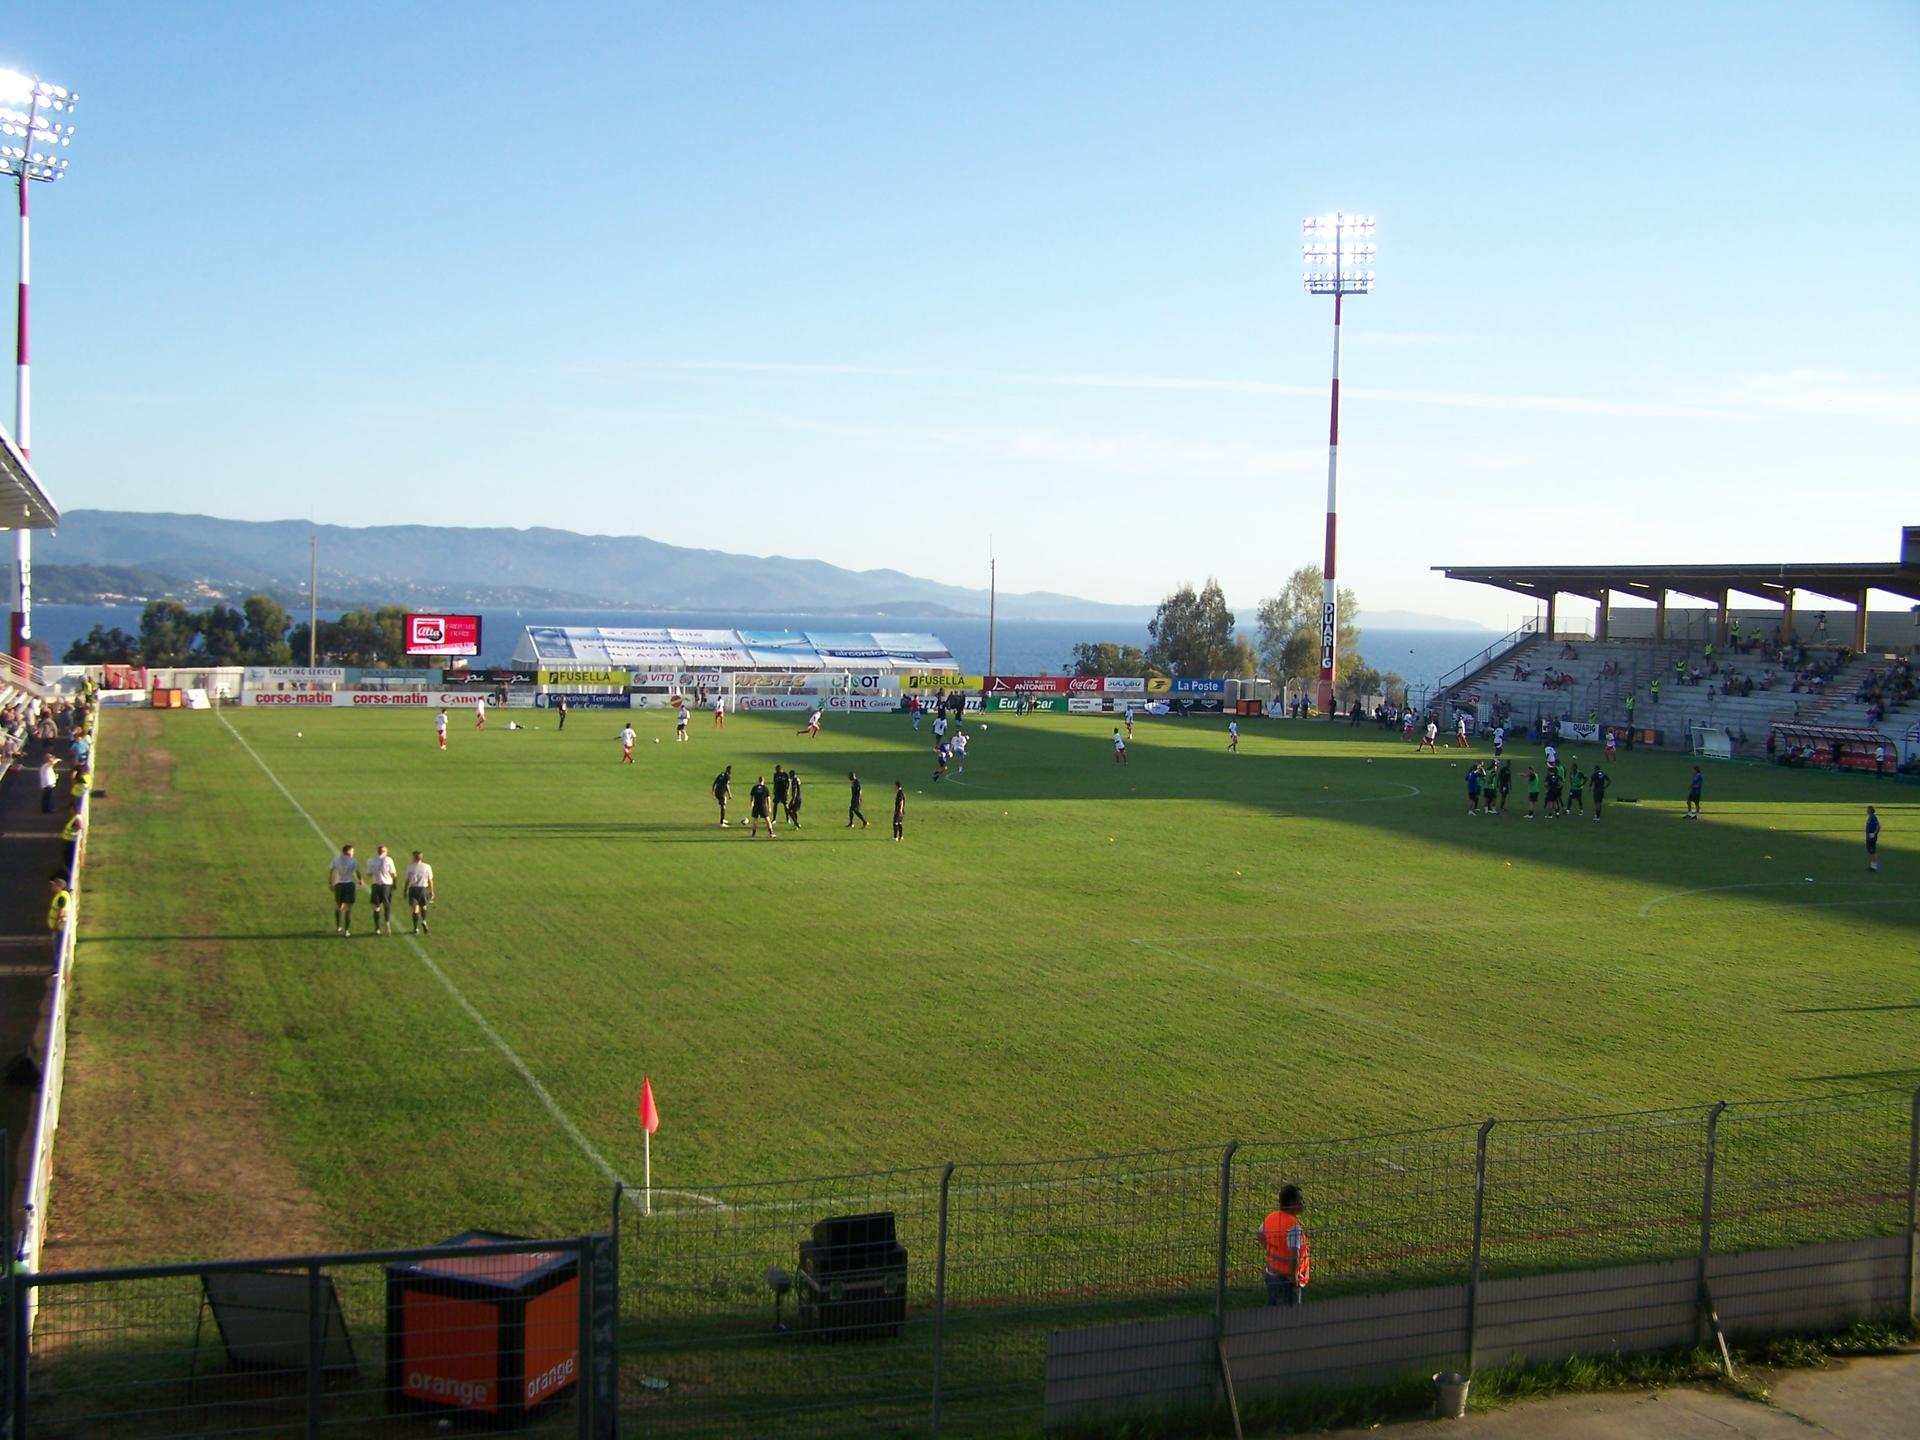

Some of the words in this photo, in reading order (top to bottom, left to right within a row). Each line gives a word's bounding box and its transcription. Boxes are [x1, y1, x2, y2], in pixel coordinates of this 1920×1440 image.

[1322, 603, 1334, 669] DUARIG
[308, 668, 342, 676] SERVICES
[560, 672, 610, 681] FUSELLA
[919, 676, 965, 685] FUSELLA
[1177, 680, 1189, 690] La
[1191, 680, 1218, 691] Poste
[1014, 683, 1056, 691] ANTONETTI
[256, 692, 333, 703] corse-matin
[353, 692, 428, 704] corse-matin
[741, 696, 777, 707] Géant
[1573, 723, 1596, 732] DUARIG
[527, 1358, 574, 1400] orange
[408, 1372, 488, 1404] orange
